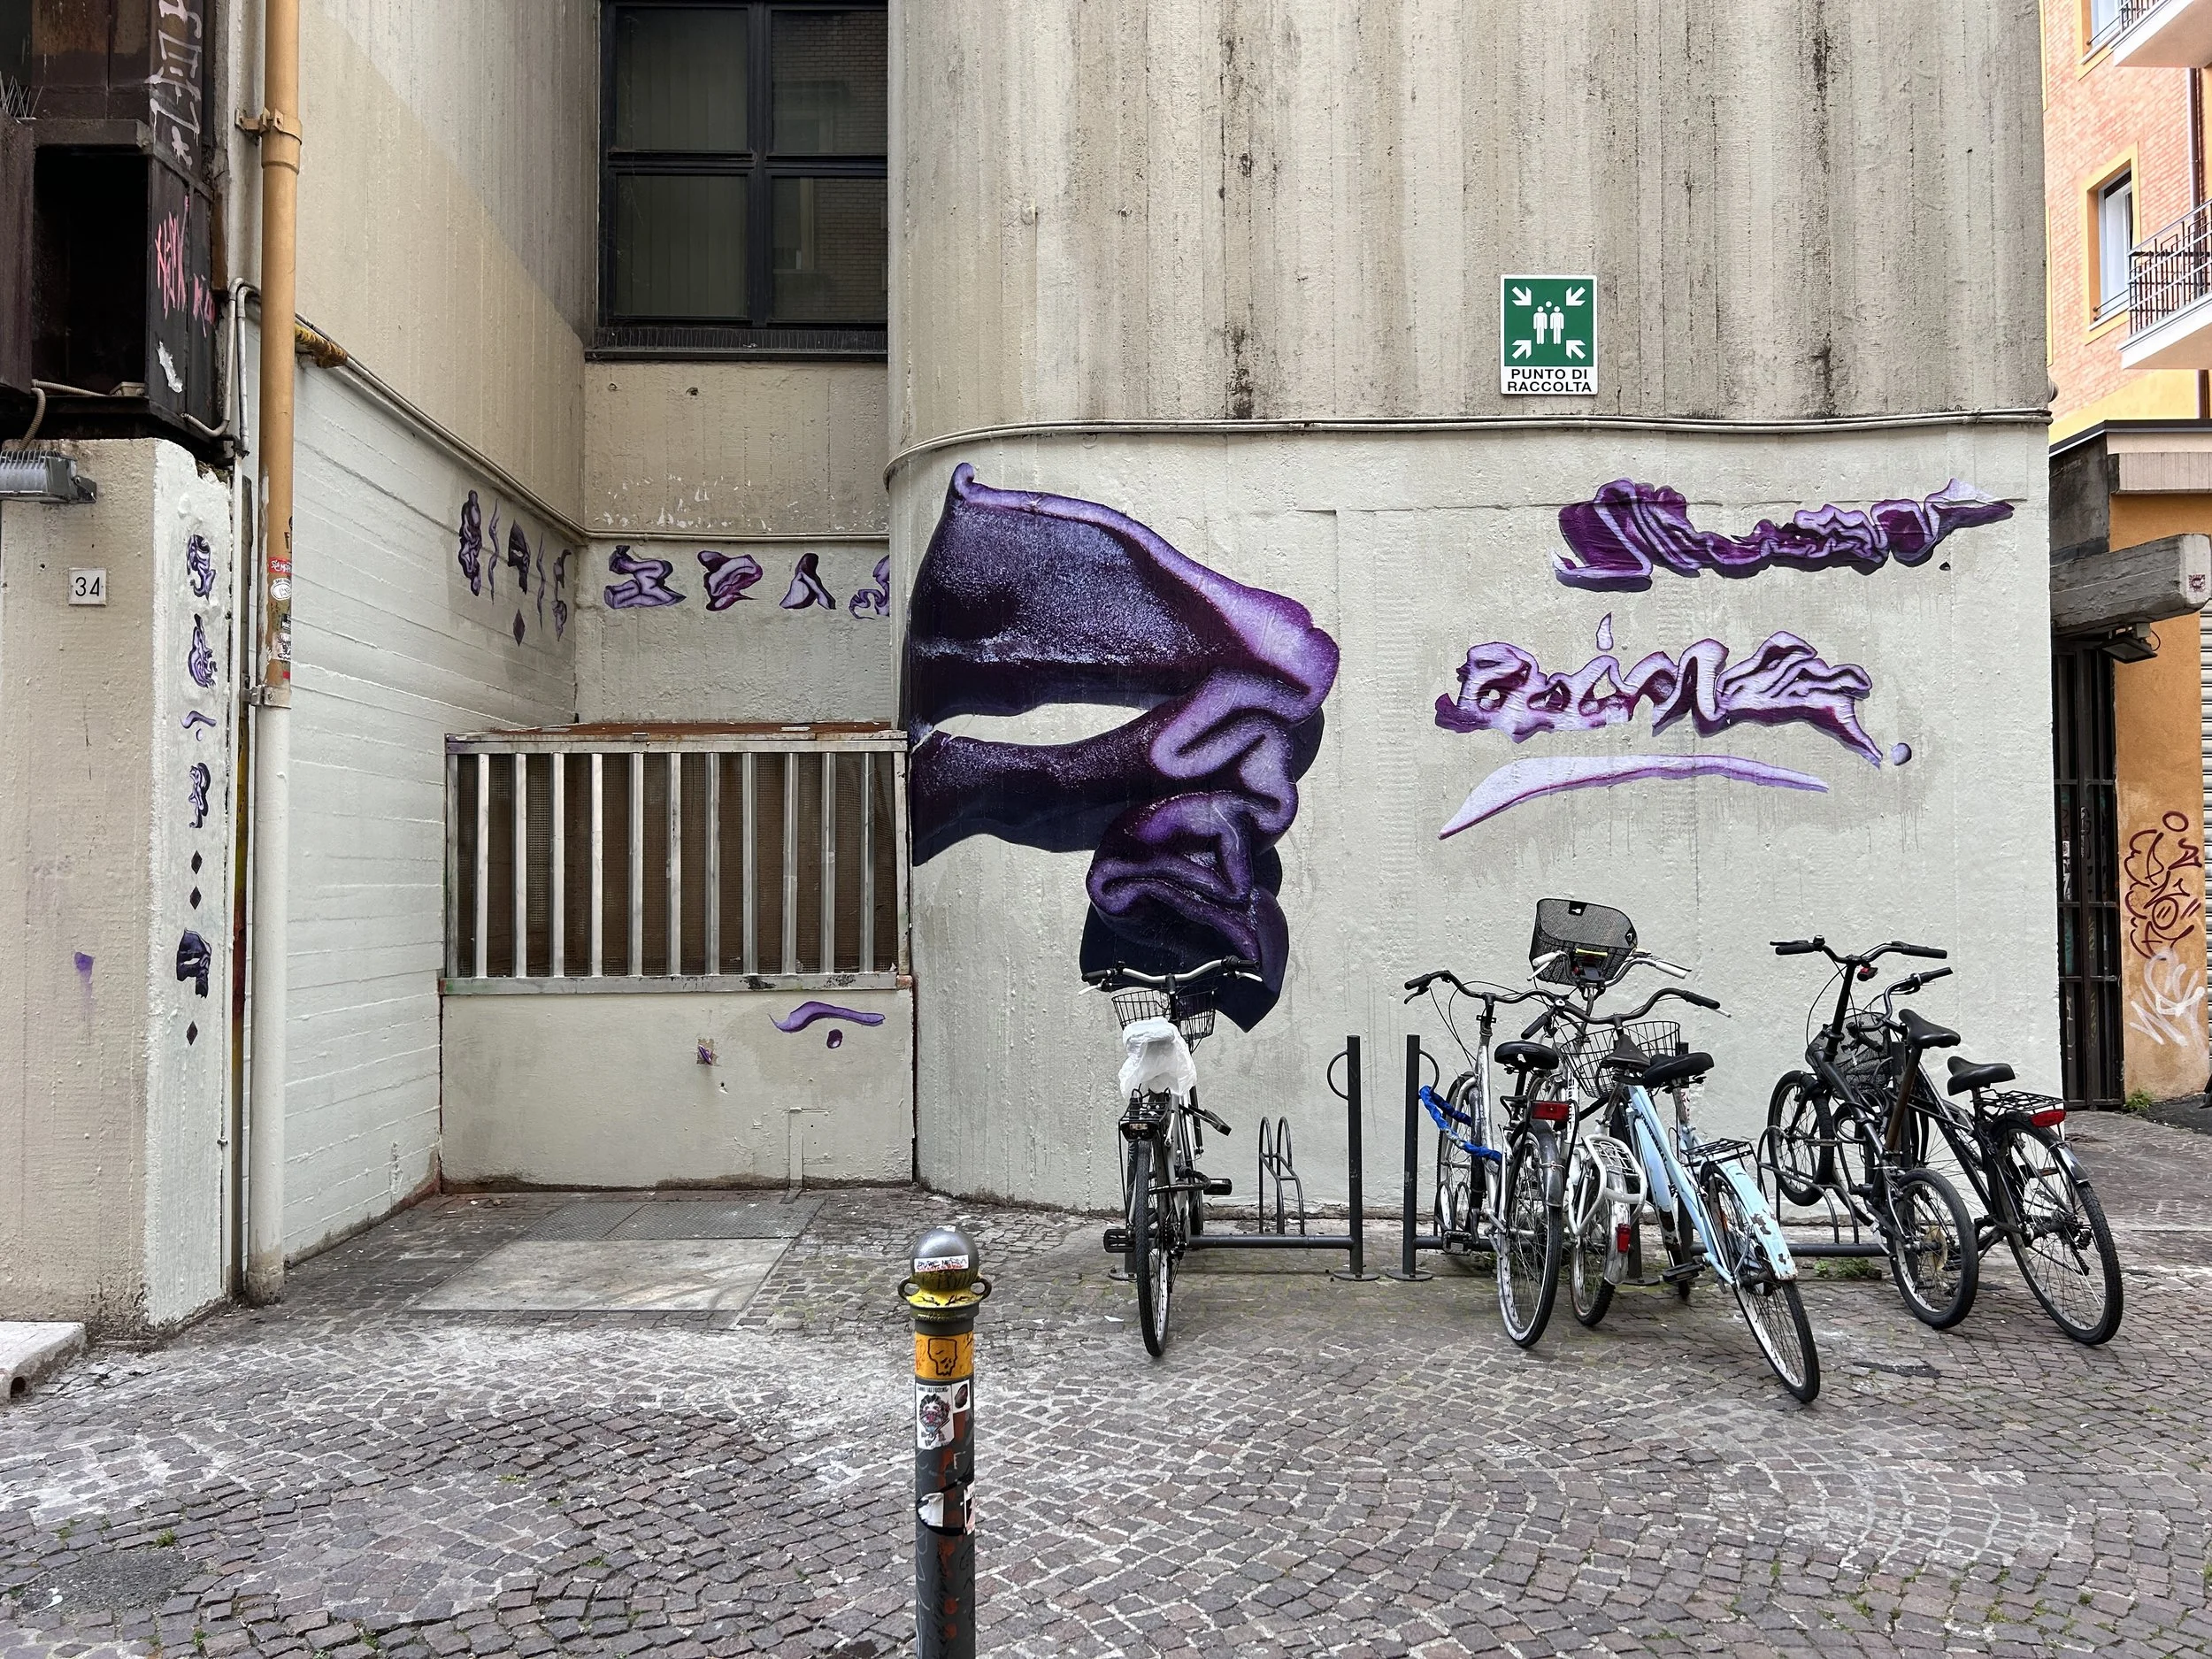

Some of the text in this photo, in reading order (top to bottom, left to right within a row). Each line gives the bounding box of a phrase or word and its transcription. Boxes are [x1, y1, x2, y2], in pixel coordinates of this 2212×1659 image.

[1511, 368, 1587, 380] PUNTO DI
[1507, 381, 1592, 392] RACCOLTA
[75, 576, 100, 596] 34
